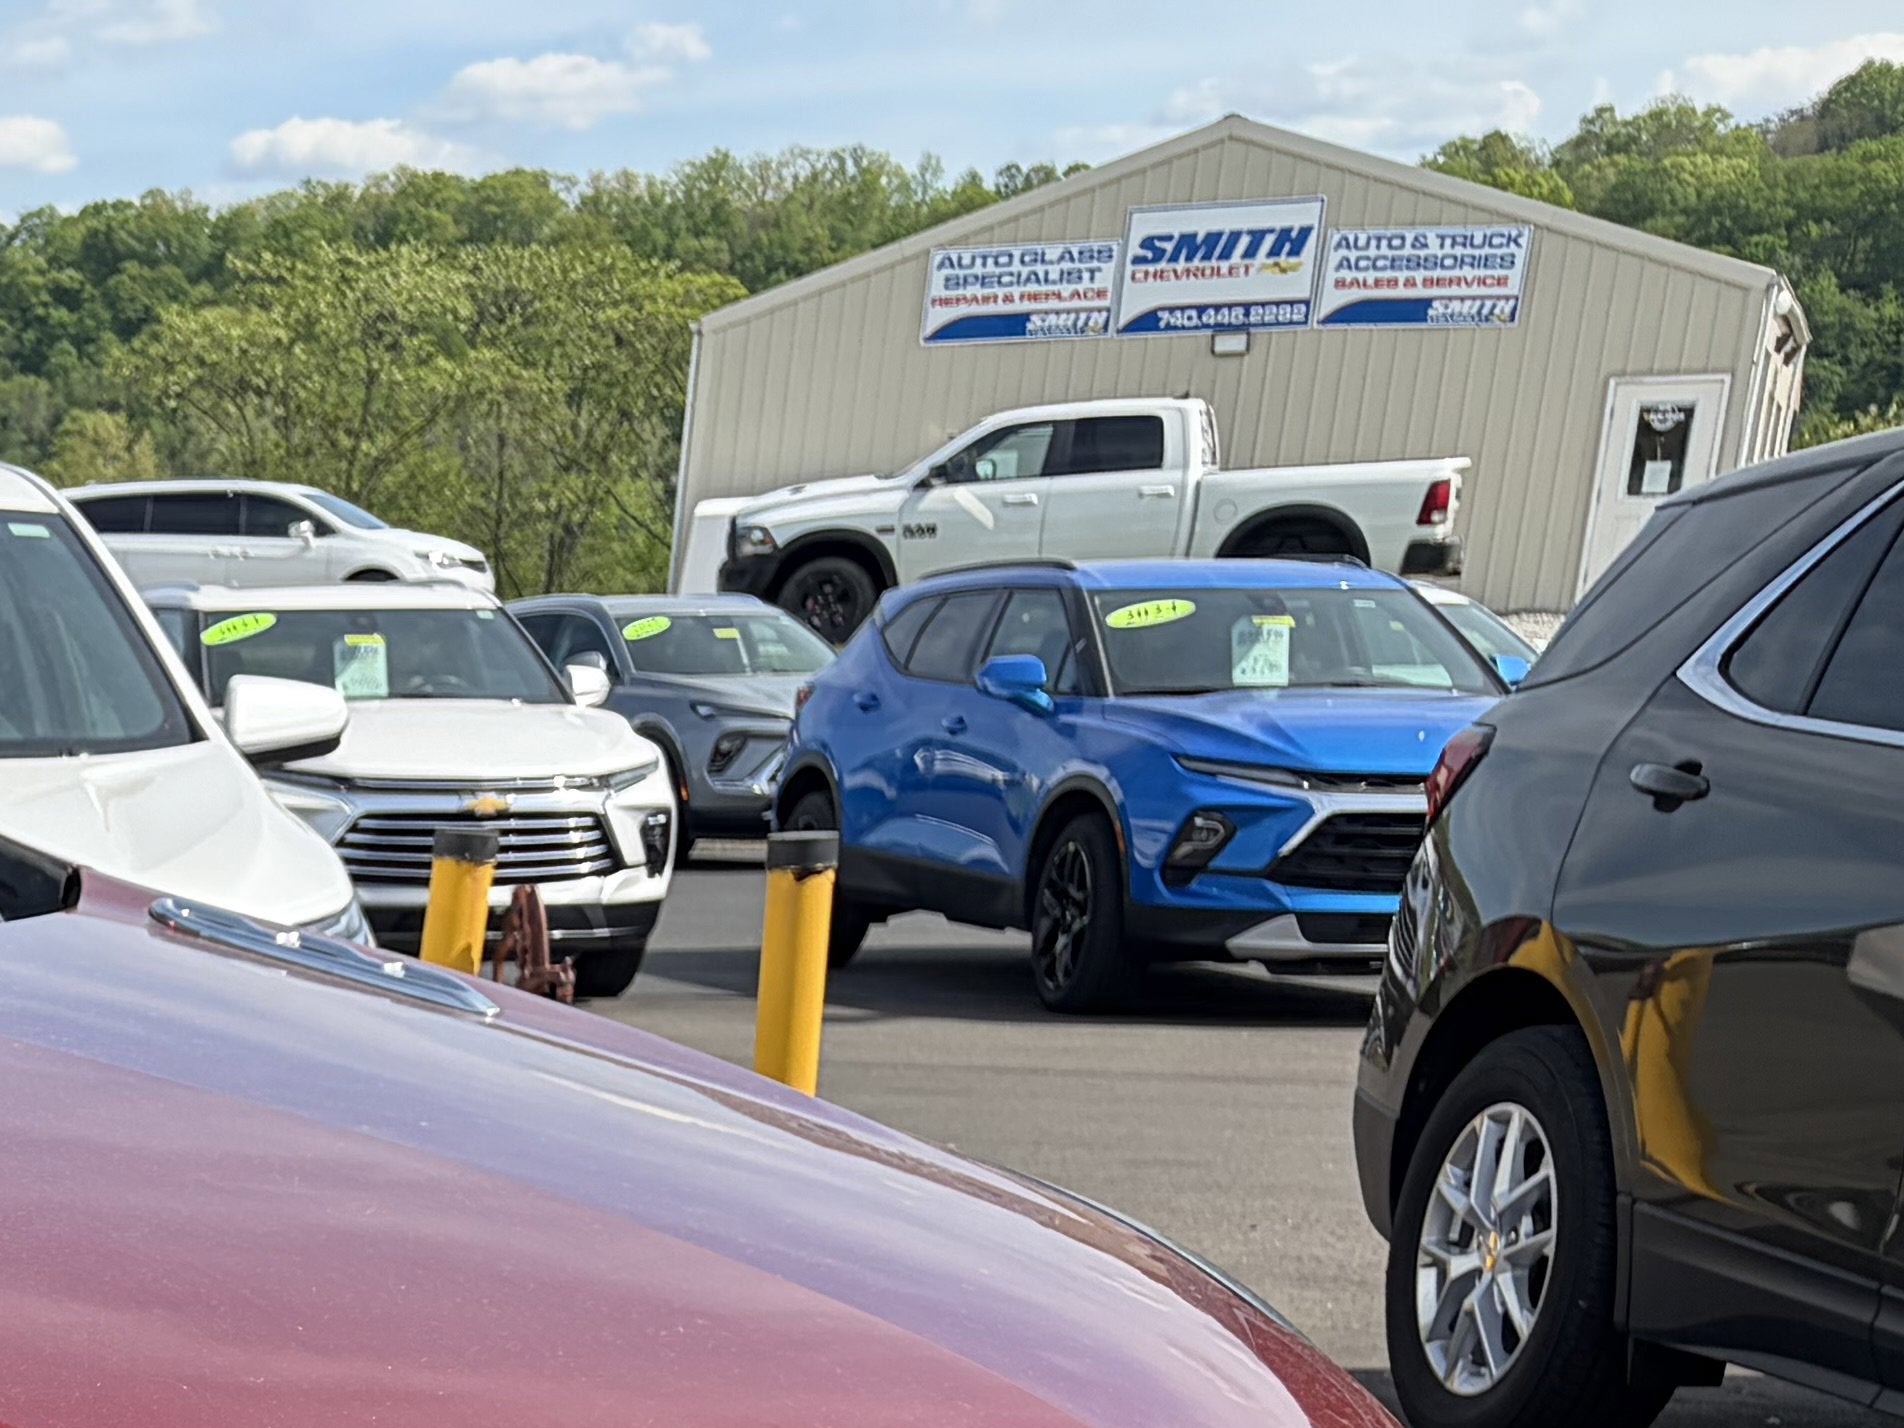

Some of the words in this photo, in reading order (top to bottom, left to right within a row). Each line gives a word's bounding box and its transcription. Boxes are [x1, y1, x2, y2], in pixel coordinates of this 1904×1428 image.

[1130, 224, 1315, 266] SMITH
[1333, 233, 1406, 251] AUTO
[1410, 233, 1429, 250] &
[1435, 231, 1524, 250] TRUCK
[936, 251, 1014, 271] AUTO
[1019, 245, 1114, 267] GLASS
[1334, 252, 1517, 273] ACCESSORIES
[943, 267, 1103, 291] SPECIALIST
[1130, 262, 1254, 284] CHEVROLET
[1334, 277, 1399, 290] SALES
[1403, 276, 1418, 289] &
[1422, 275, 1510, 289] SERVICE
[931, 294, 998, 309] REPAIR
[1019, 288, 1108, 304] REPLACE
